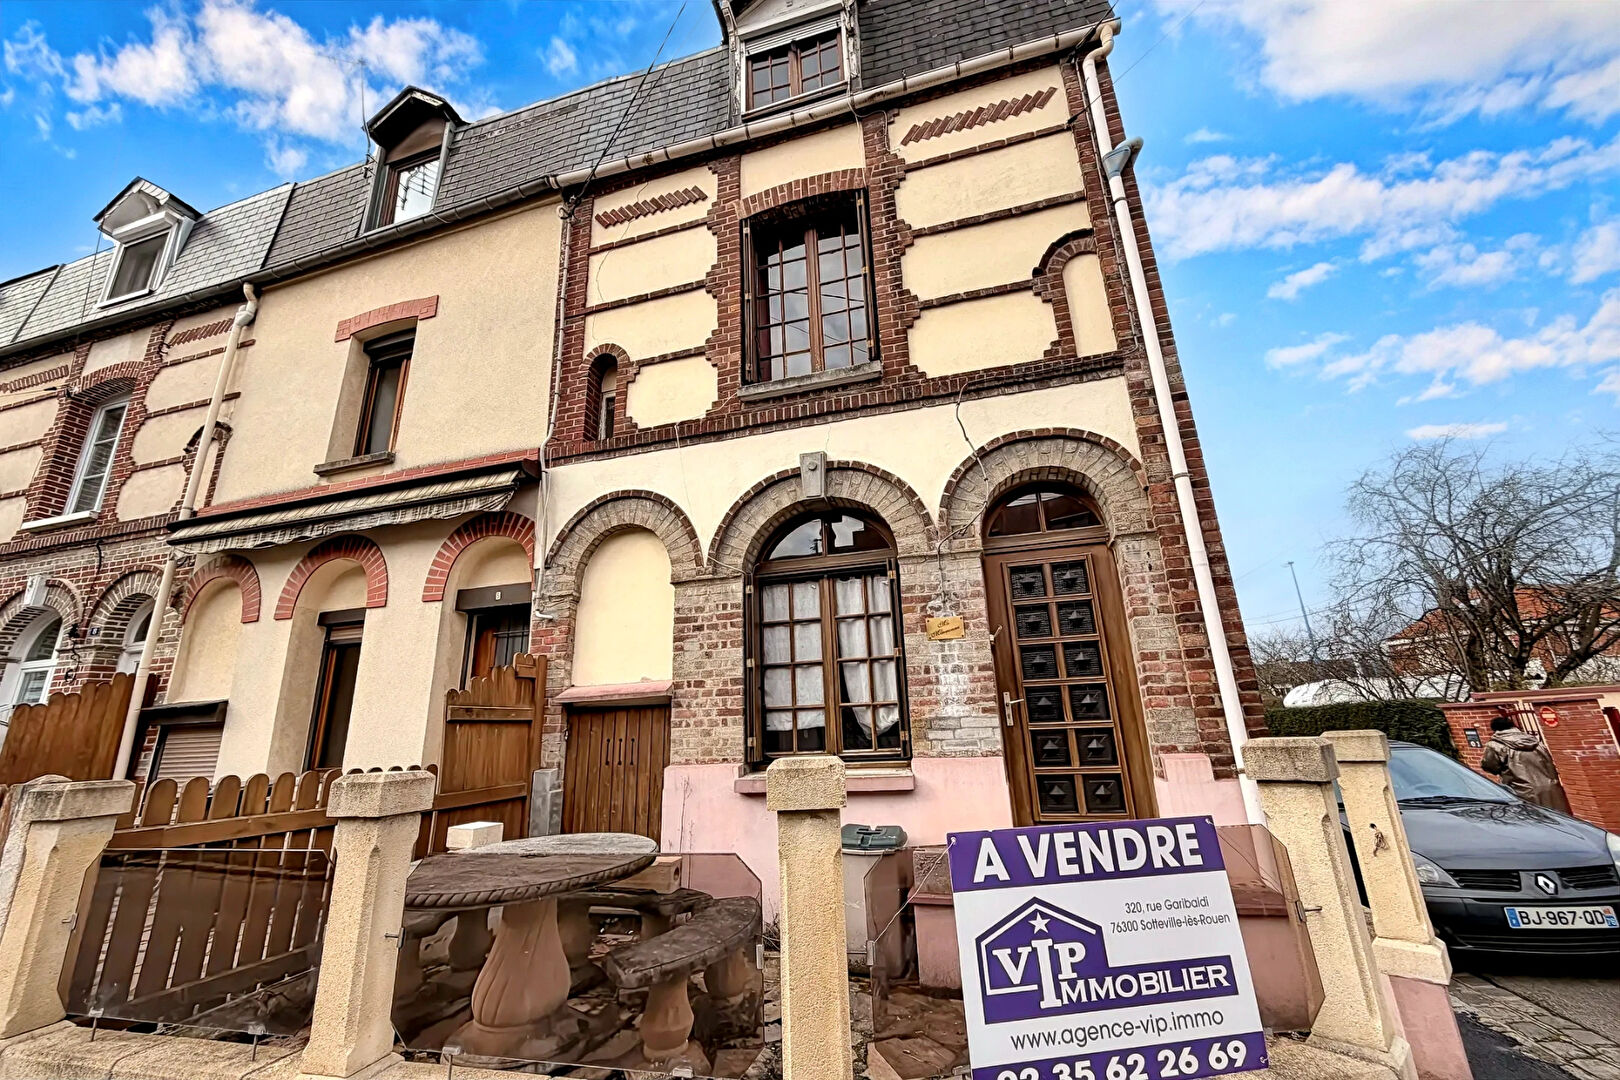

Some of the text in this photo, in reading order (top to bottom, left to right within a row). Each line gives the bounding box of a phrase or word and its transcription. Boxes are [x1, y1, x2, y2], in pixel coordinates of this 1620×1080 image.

[973, 823, 1204, 883] A VENDRE
[1110, 914, 1231, 934] 76300 Sotteville-lès-Rouen
[1125, 896, 1210, 914] 320, rue Garibaldi
[1518, 910, 1605, 926] BJ-967-QD
[992, 938, 1086, 1009] VIP
[1010, 1009, 1224, 1051] www.agence-vip.immo
[1052, 1060, 1096, 1080] 35
[1106, 1053, 1149, 1080] 62
[1157, 1046, 1199, 1078] 26
[1208, 1040, 1247, 1071] 69
